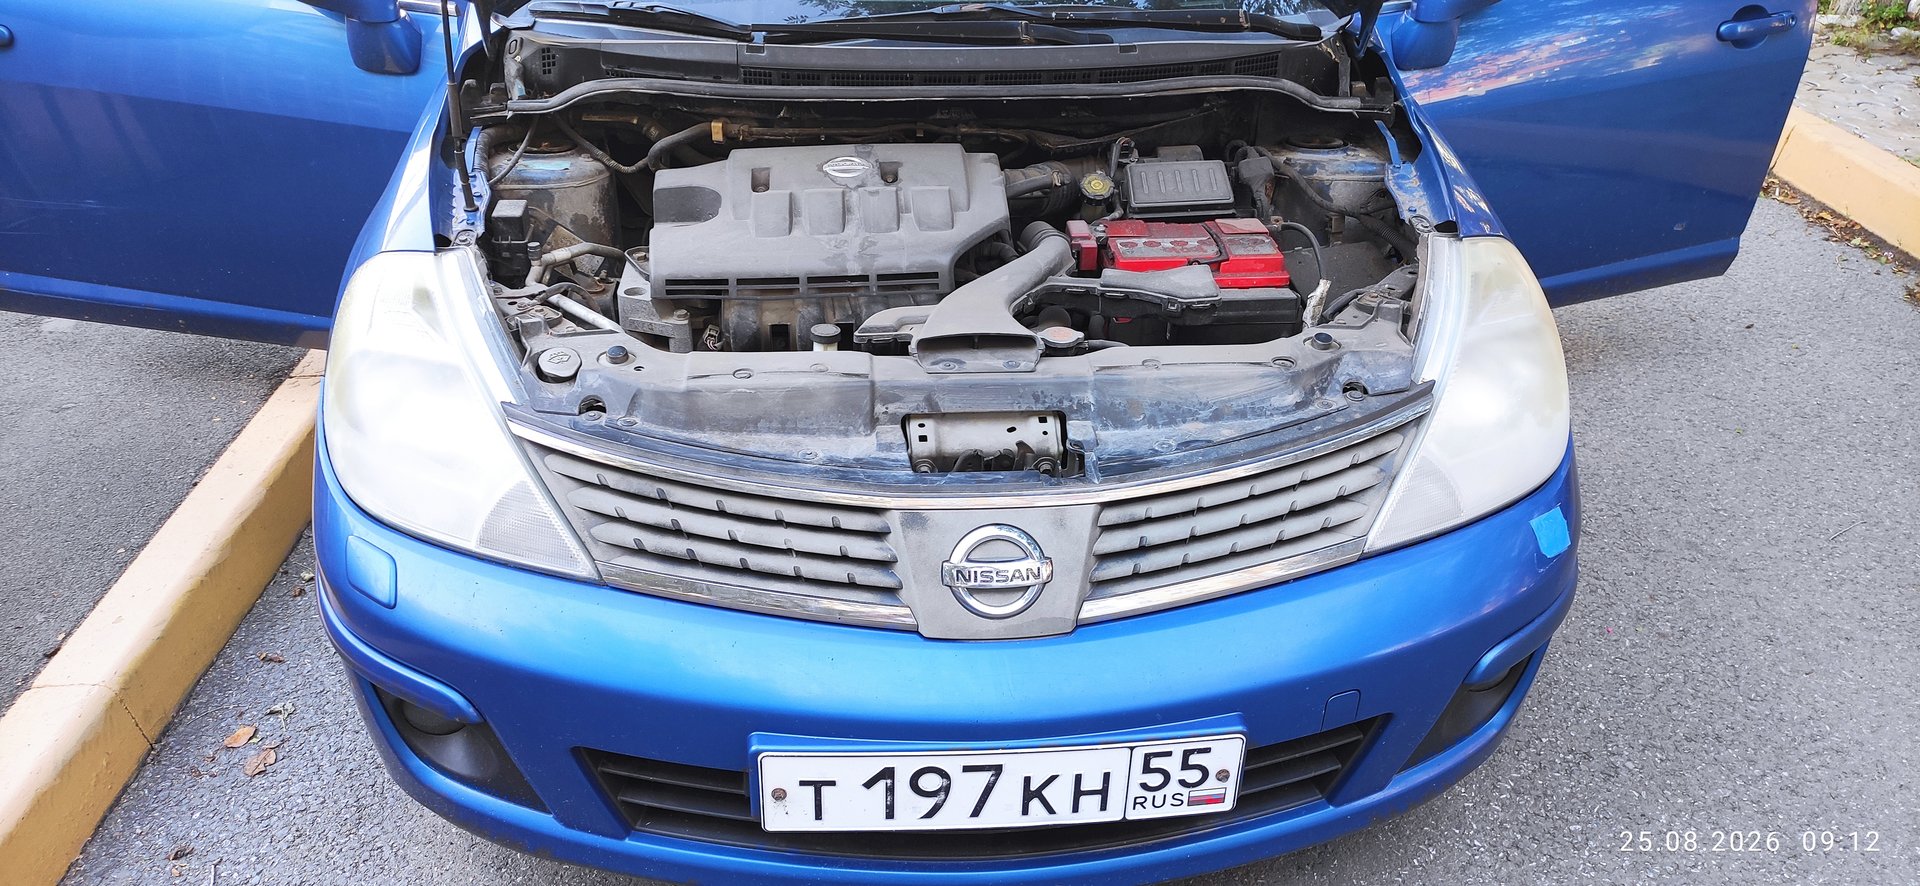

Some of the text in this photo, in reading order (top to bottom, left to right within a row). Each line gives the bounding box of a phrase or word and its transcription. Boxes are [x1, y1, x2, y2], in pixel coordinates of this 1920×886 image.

[955, 566, 1041, 583] NISSAN
[1138, 747, 1211, 793] 55
[862, 764, 1003, 820] 197
[1132, 793, 1184, 810] RUS
